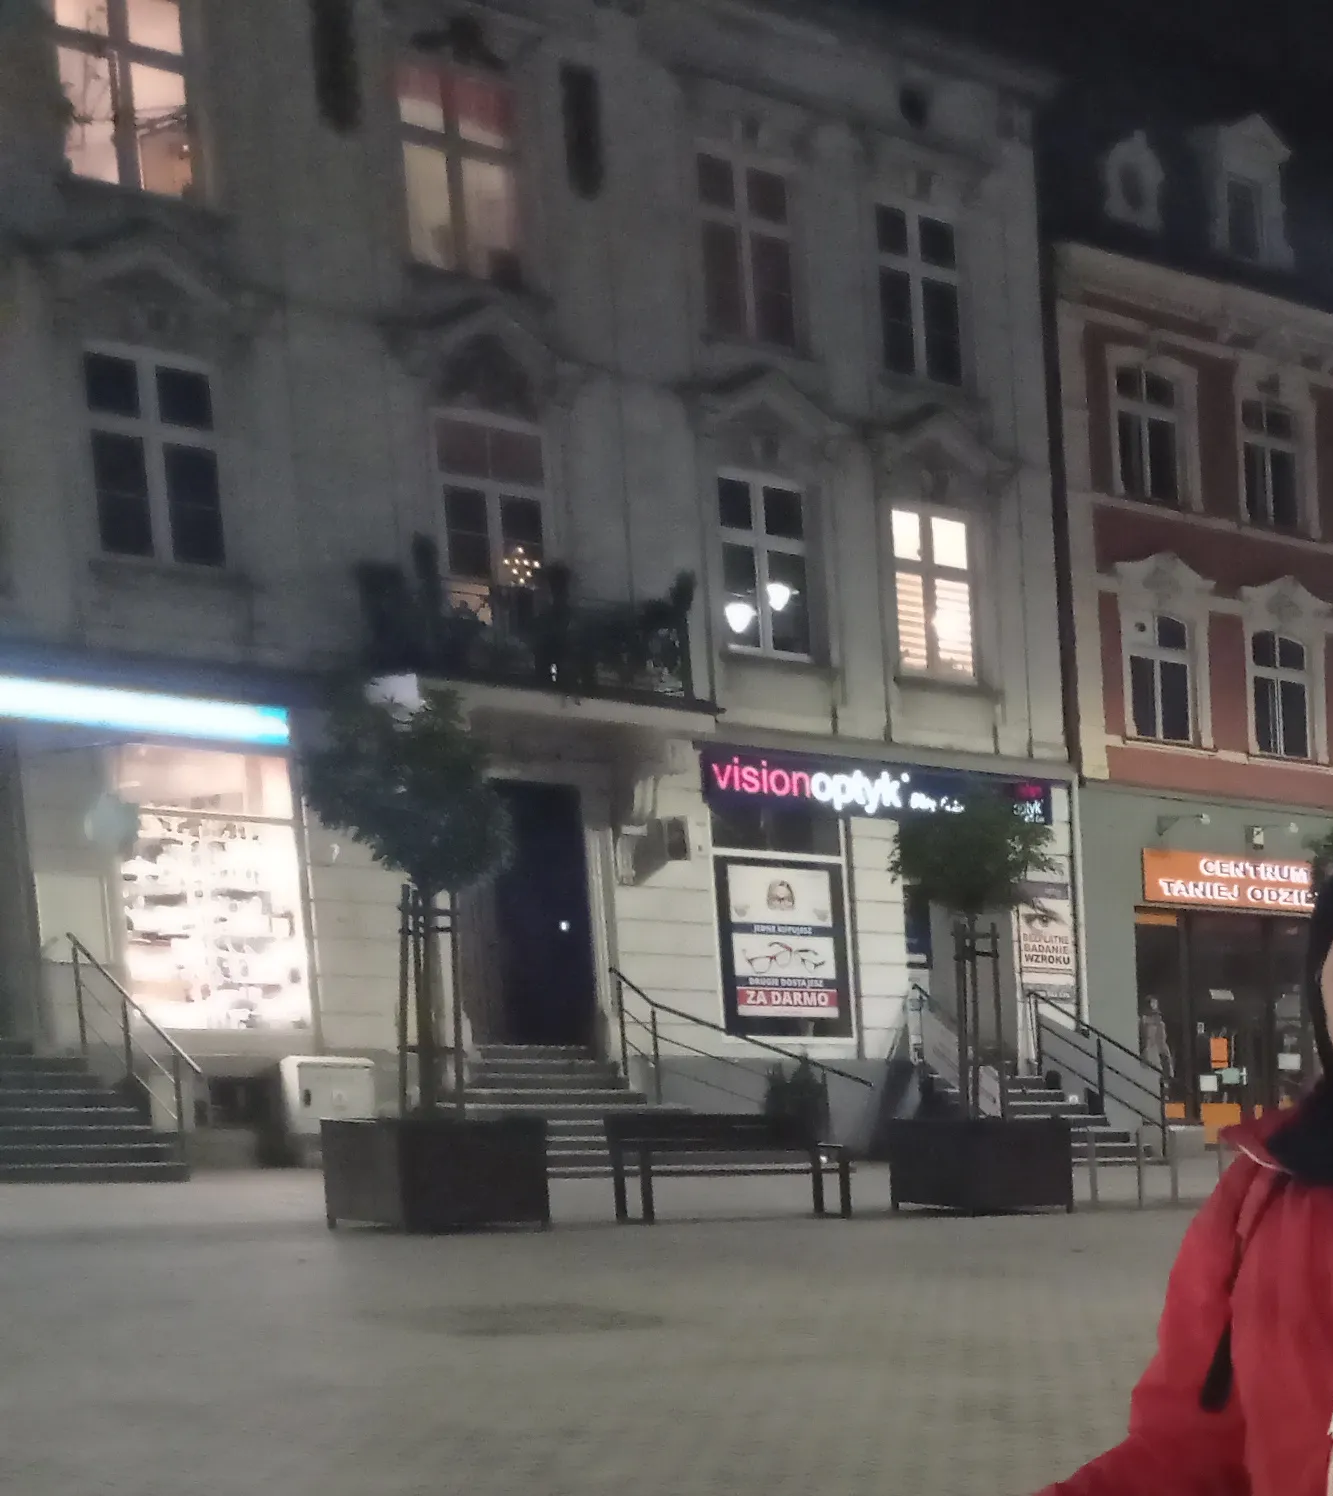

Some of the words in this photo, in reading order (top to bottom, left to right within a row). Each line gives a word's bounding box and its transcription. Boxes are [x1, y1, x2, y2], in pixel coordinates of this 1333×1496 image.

[1200, 858, 1309, 884] CENTRUM
[1160, 878, 1240, 900] TANIEJ
[1023, 943, 1069, 954] BADANIE
[1024, 954, 1070, 965] WZROKU
[746, 990, 768, 1005] ZA
[771, 991, 829, 1006] DARMO
